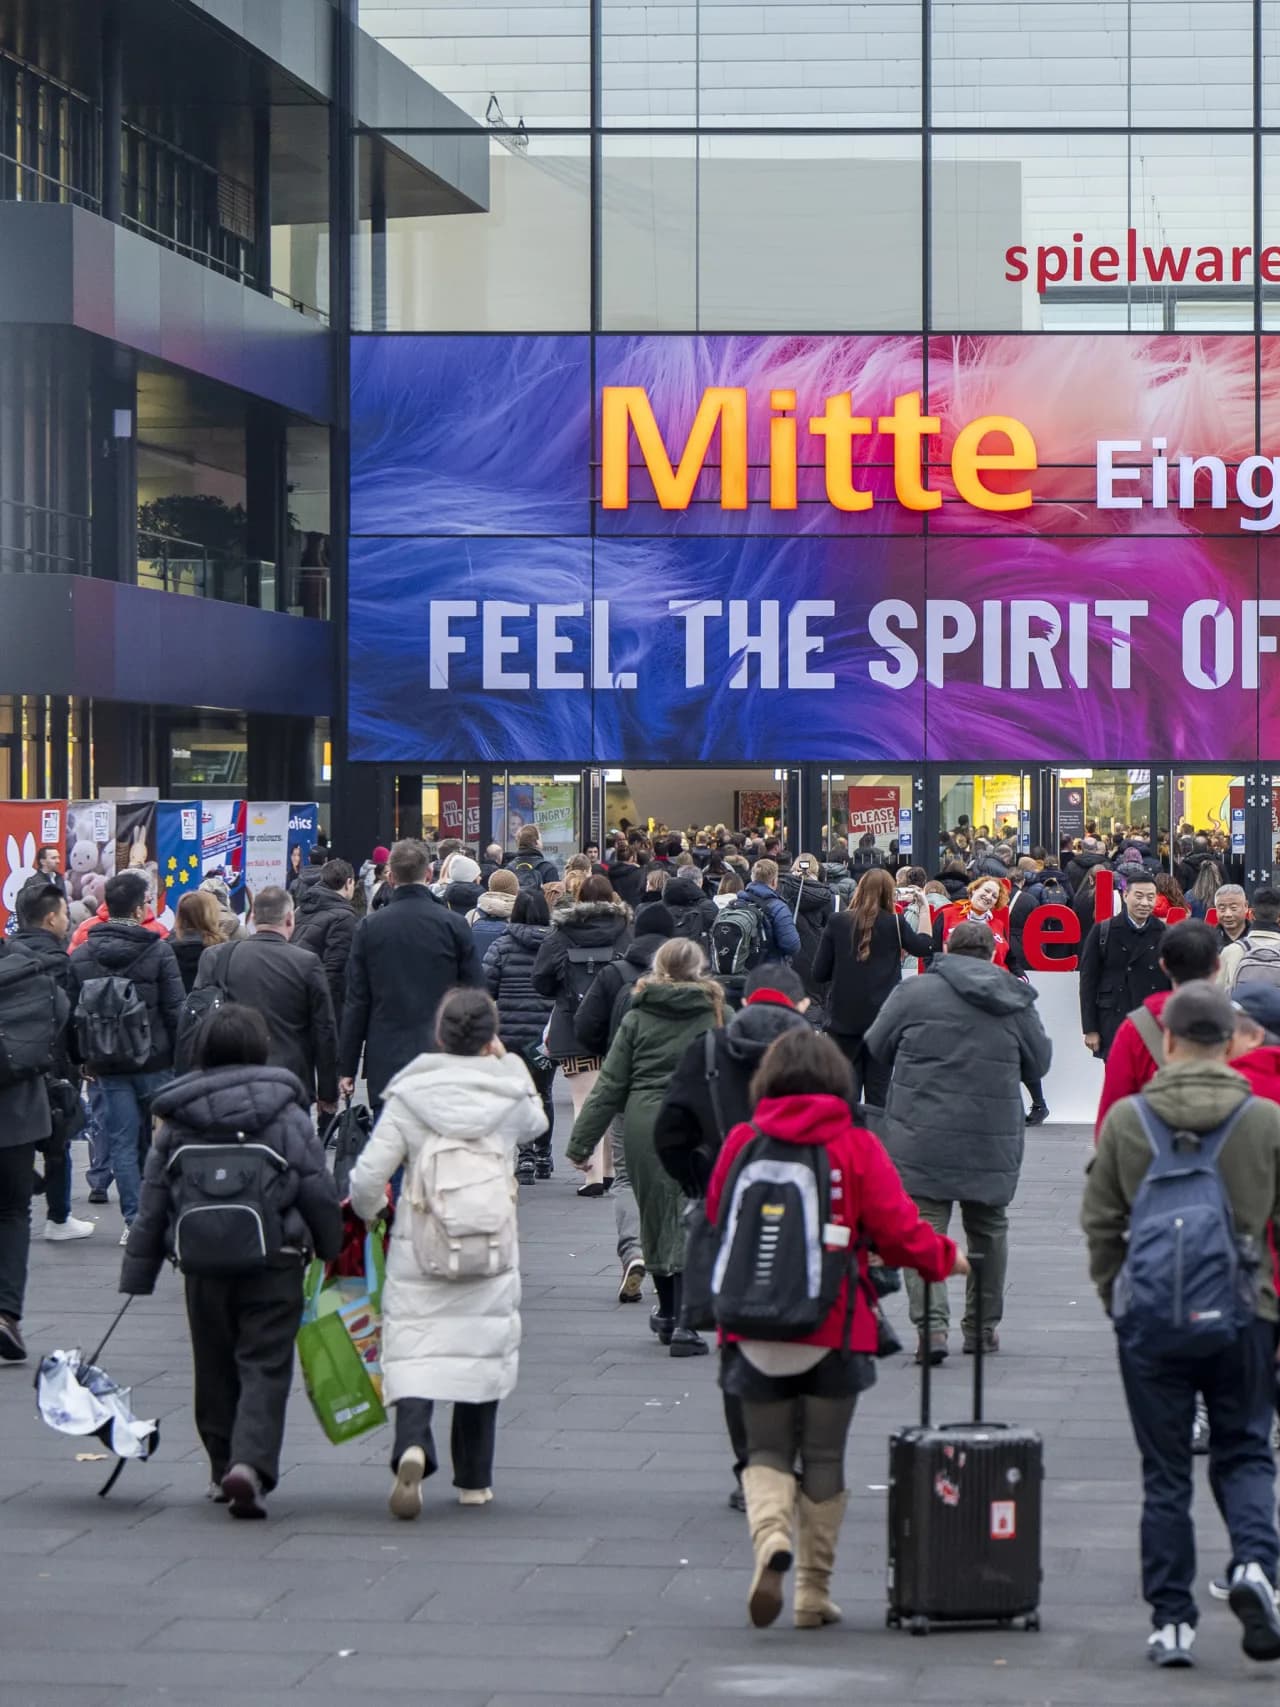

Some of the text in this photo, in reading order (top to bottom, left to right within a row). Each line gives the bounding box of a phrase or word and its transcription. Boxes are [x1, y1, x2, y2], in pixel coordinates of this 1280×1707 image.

[602, 386, 1038, 512] Mitte
[429, 599, 637, 689] FEEL
[668, 600, 836, 689] THE
[868, 598, 1149, 690] SPIRIT
[444, 807, 480, 827] TICKE
[534, 807, 571, 823] UNGRY?
[852, 807, 894, 826] PLEASE
[866, 820, 897, 835] NOTE
